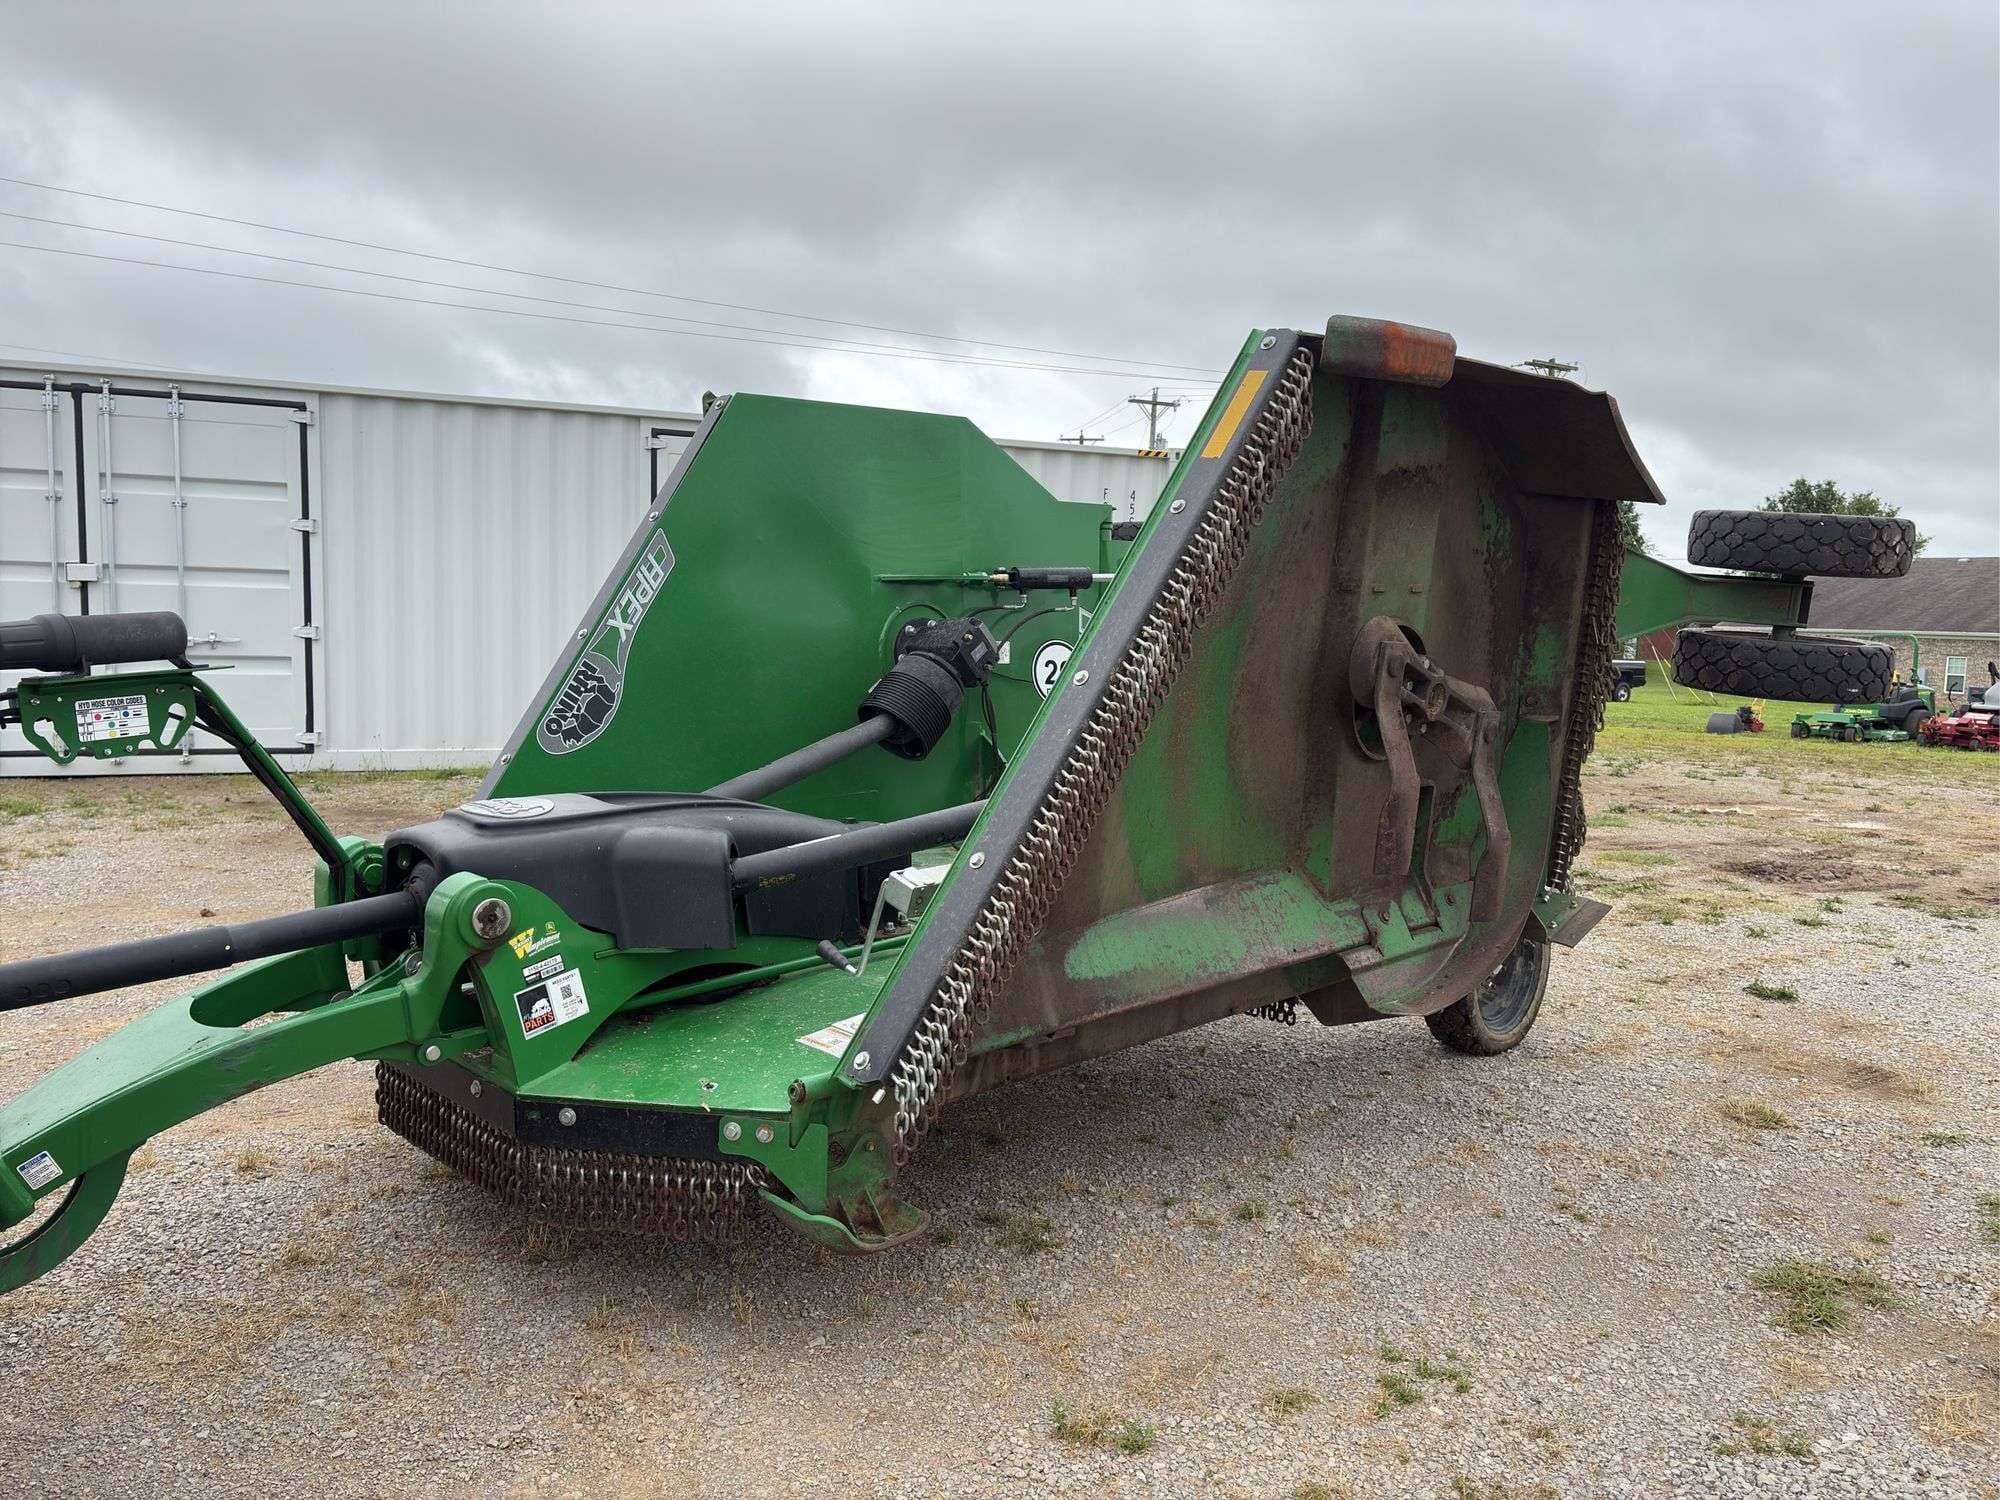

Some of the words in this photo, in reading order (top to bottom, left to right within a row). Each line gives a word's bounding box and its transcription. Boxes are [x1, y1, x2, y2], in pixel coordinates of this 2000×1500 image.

[606, 551, 665, 643] APEX
[1044, 659, 1068, 685] 2
[78, 702, 91, 710] HYD
[91, 700, 106, 709] HOSE
[106, 698, 125, 707] COLOR
[125, 697, 144, 705] CODES
[543, 658, 599, 737] RHINO
[524, 1012, 554, 1031] PARTS
